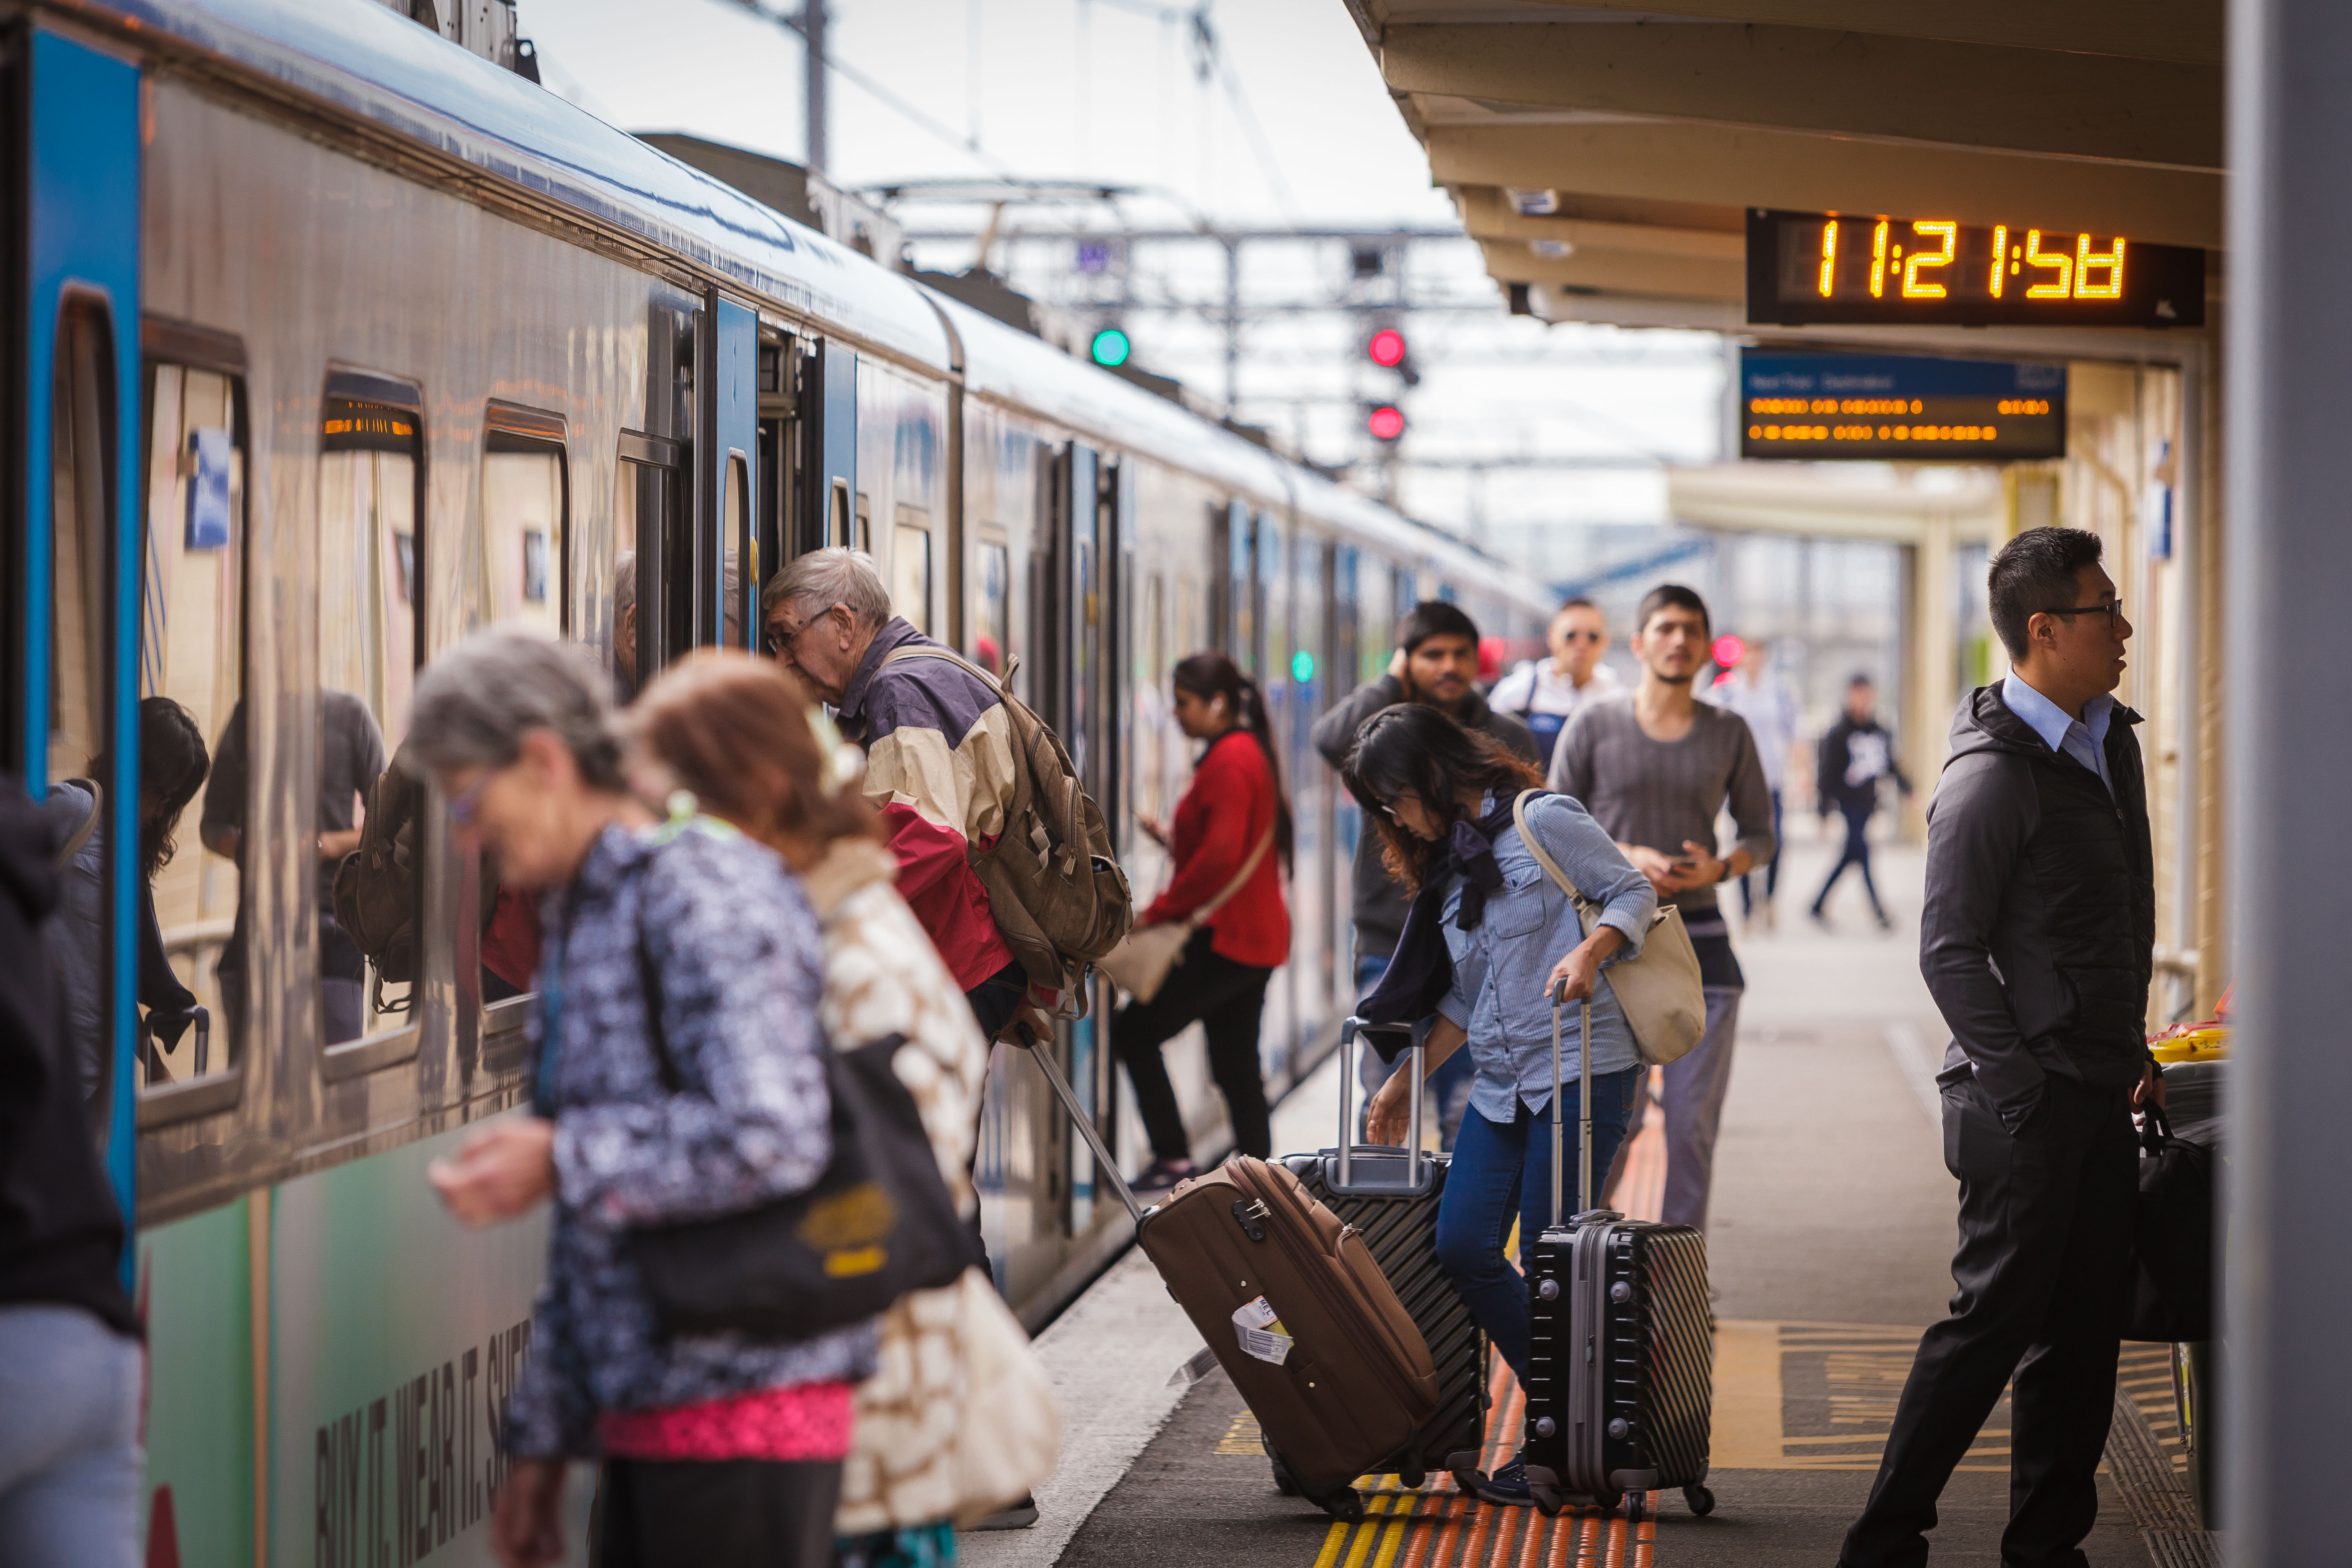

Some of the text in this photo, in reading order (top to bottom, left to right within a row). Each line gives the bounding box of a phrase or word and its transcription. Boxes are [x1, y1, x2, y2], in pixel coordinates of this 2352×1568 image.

[1259, 1298, 1272, 1316] MEL
[315, 1410, 362, 1568] BUY
[395, 1360, 456, 1567] WEAR
[462, 1346, 481, 1530] IT.
